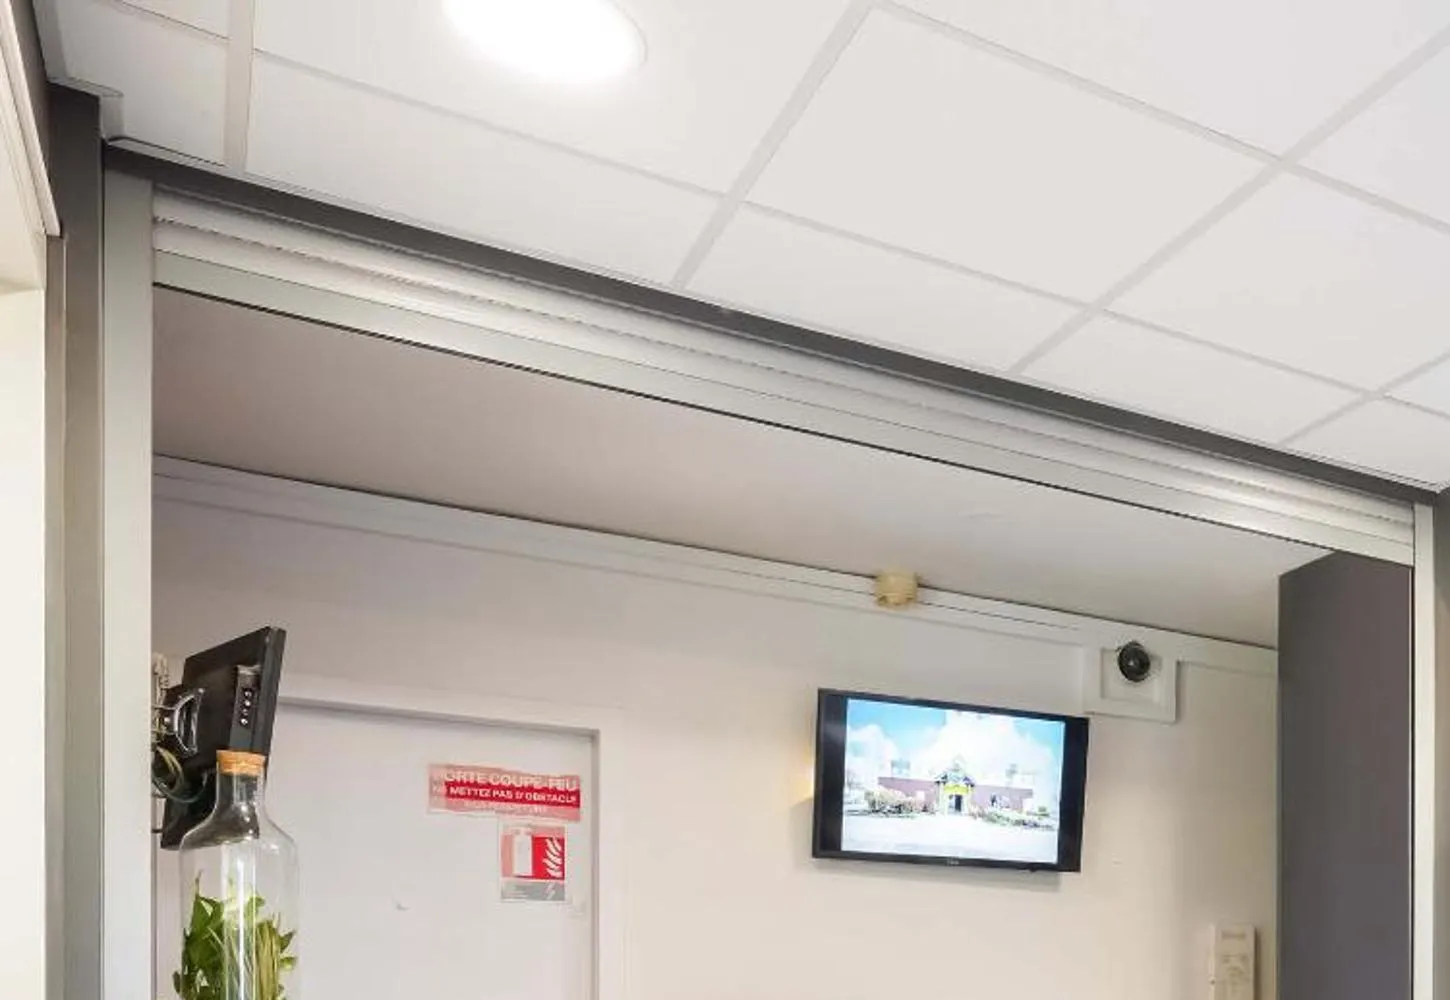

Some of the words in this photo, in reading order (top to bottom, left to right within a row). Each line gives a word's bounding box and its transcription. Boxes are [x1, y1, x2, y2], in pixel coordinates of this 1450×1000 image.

[433, 769, 488, 784] ORTE
[450, 786, 490, 798] METTEZ
[493, 789, 513, 800] PAS
